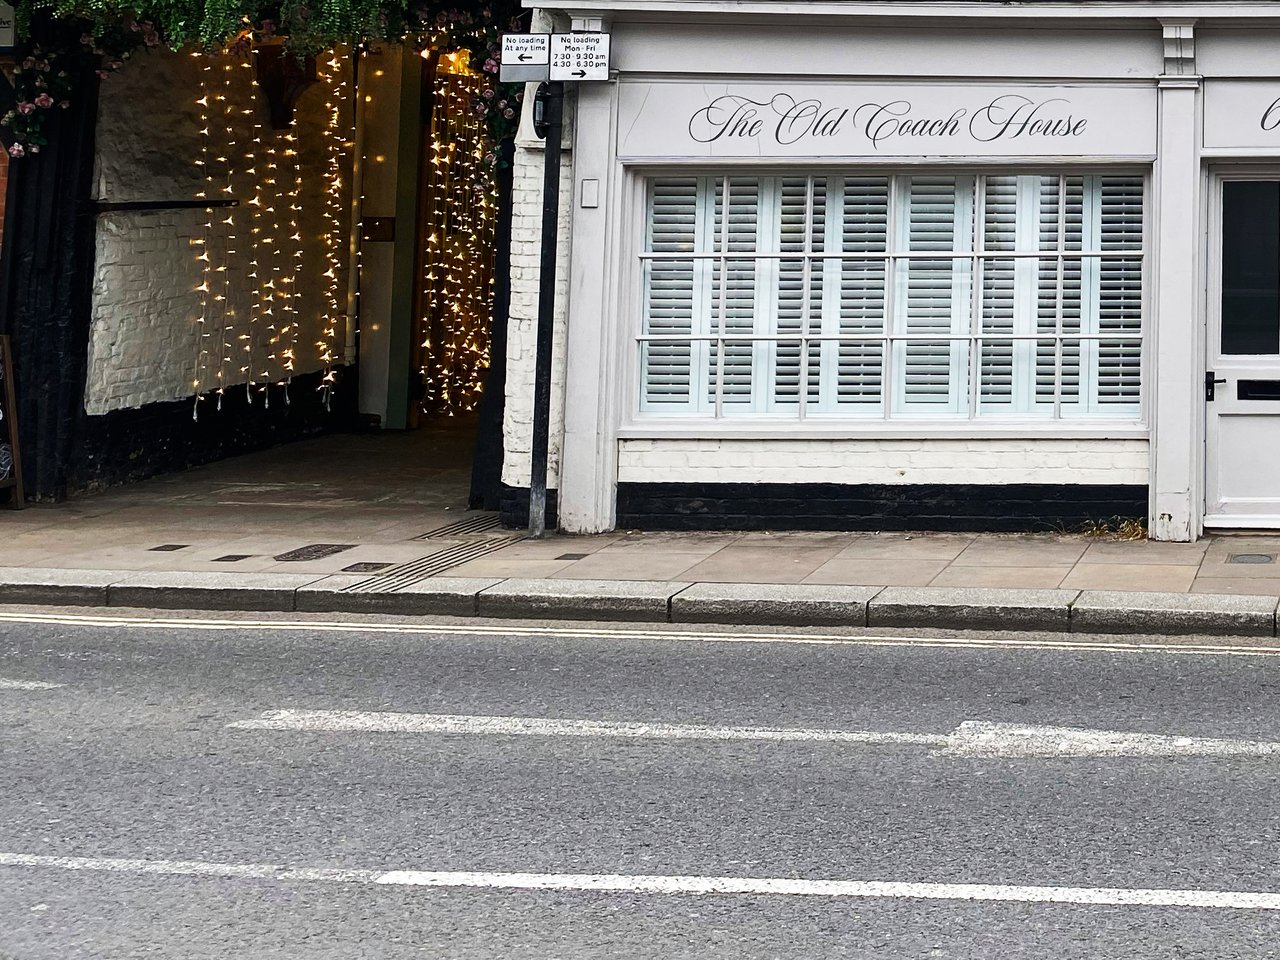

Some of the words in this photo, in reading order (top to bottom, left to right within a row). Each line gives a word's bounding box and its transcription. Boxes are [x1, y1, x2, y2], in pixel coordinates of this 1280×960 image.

[688, 95, 776, 142] The
[771, 92, 850, 145] Old
[853, 100, 967, 151] Coach
[969, 94, 1088, 142] House
